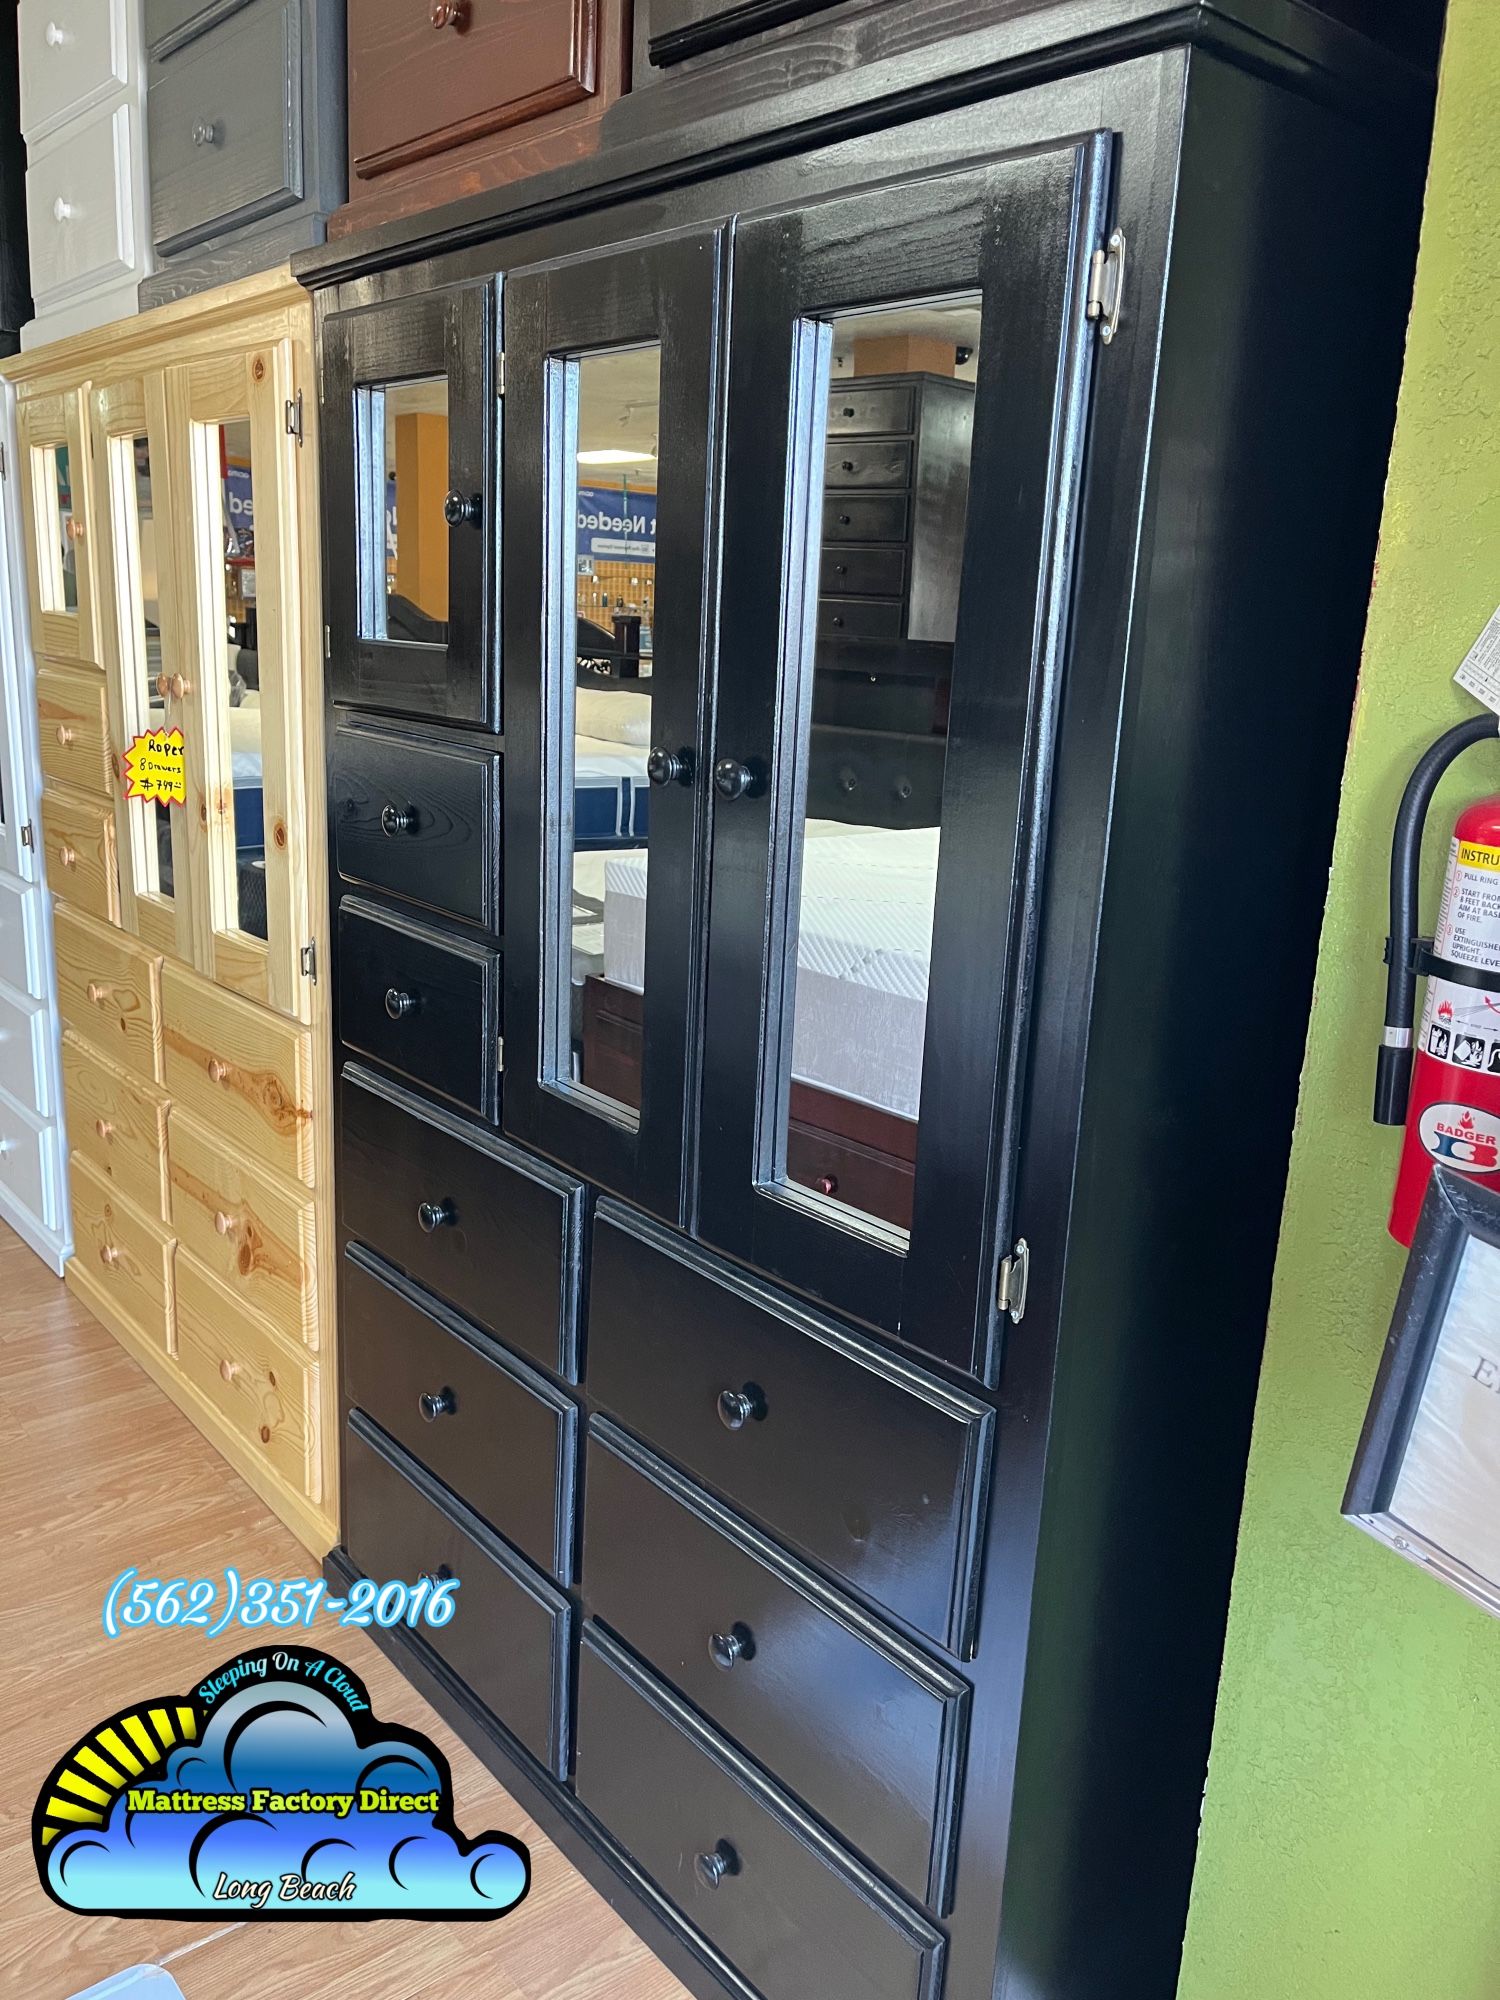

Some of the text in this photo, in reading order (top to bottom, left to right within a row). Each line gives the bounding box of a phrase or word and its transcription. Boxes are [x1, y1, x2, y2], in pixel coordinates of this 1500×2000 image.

[140, 757, 146, 771] 8
[1461, 847, 1500, 866] INSTRU
[1464, 872, 1478, 882] PULL
[1480, 876, 1499, 886] RING
[1461, 887, 1481, 898] START
[1465, 897, 1480, 907] FEET
[1472, 907, 1481, 915] AT
[1451, 949, 1479, 963] SQUEEZE
[1437, 1121, 1497, 1145] BADGER
